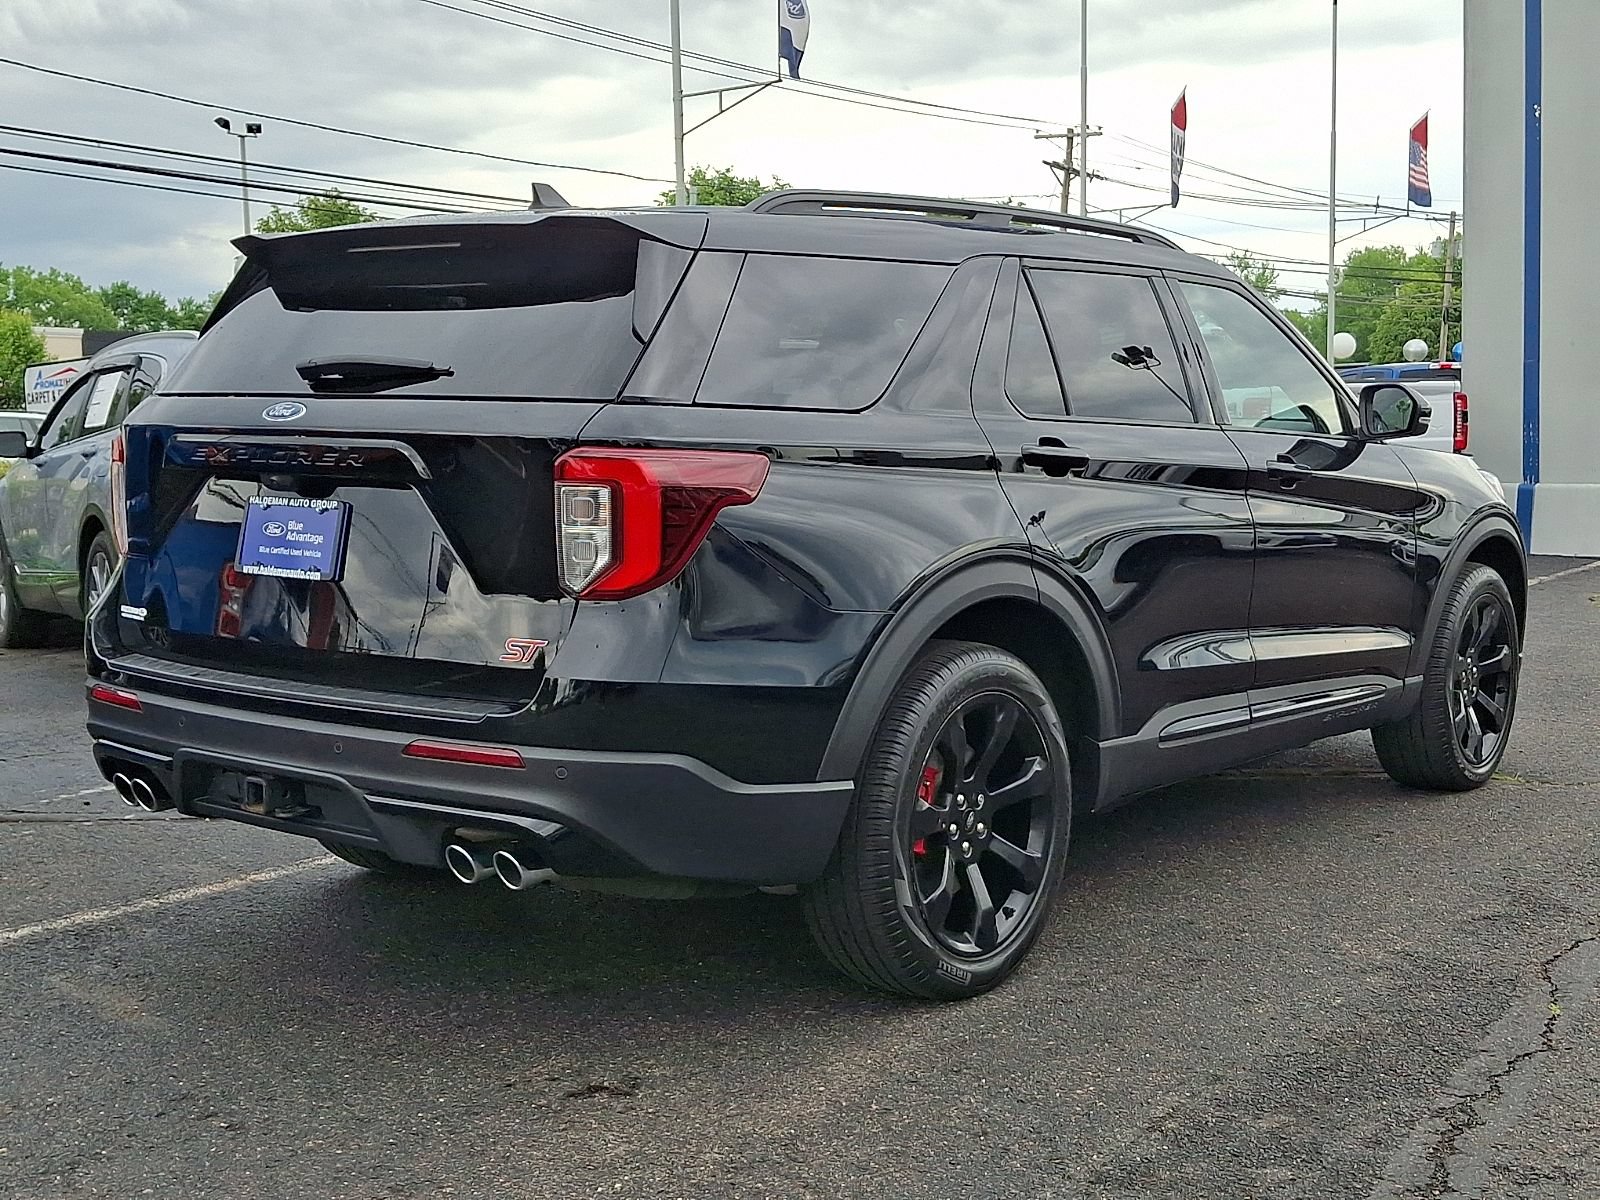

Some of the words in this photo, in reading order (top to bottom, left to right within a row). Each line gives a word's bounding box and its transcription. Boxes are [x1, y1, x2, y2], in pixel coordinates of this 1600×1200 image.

[27, 389, 50, 405] CARPET
[267, 402, 299, 418] Ford
[191, 447, 365, 467] EXPLORER
[249, 496, 289, 507] HALDEMAN
[289, 499, 309, 507] AUTO
[311, 500, 338, 509] GROUP
[288, 520, 304, 531] Blue
[286, 531, 324, 545] Advantage
[258, 546, 269, 554] Blue
[271, 546, 290, 555] Certified
[290, 548, 302, 556] Used
[303, 549, 322, 558] Vehicle
[243, 565, 321, 580] www.haldemanauto.com
[499, 637, 549, 663] ST
